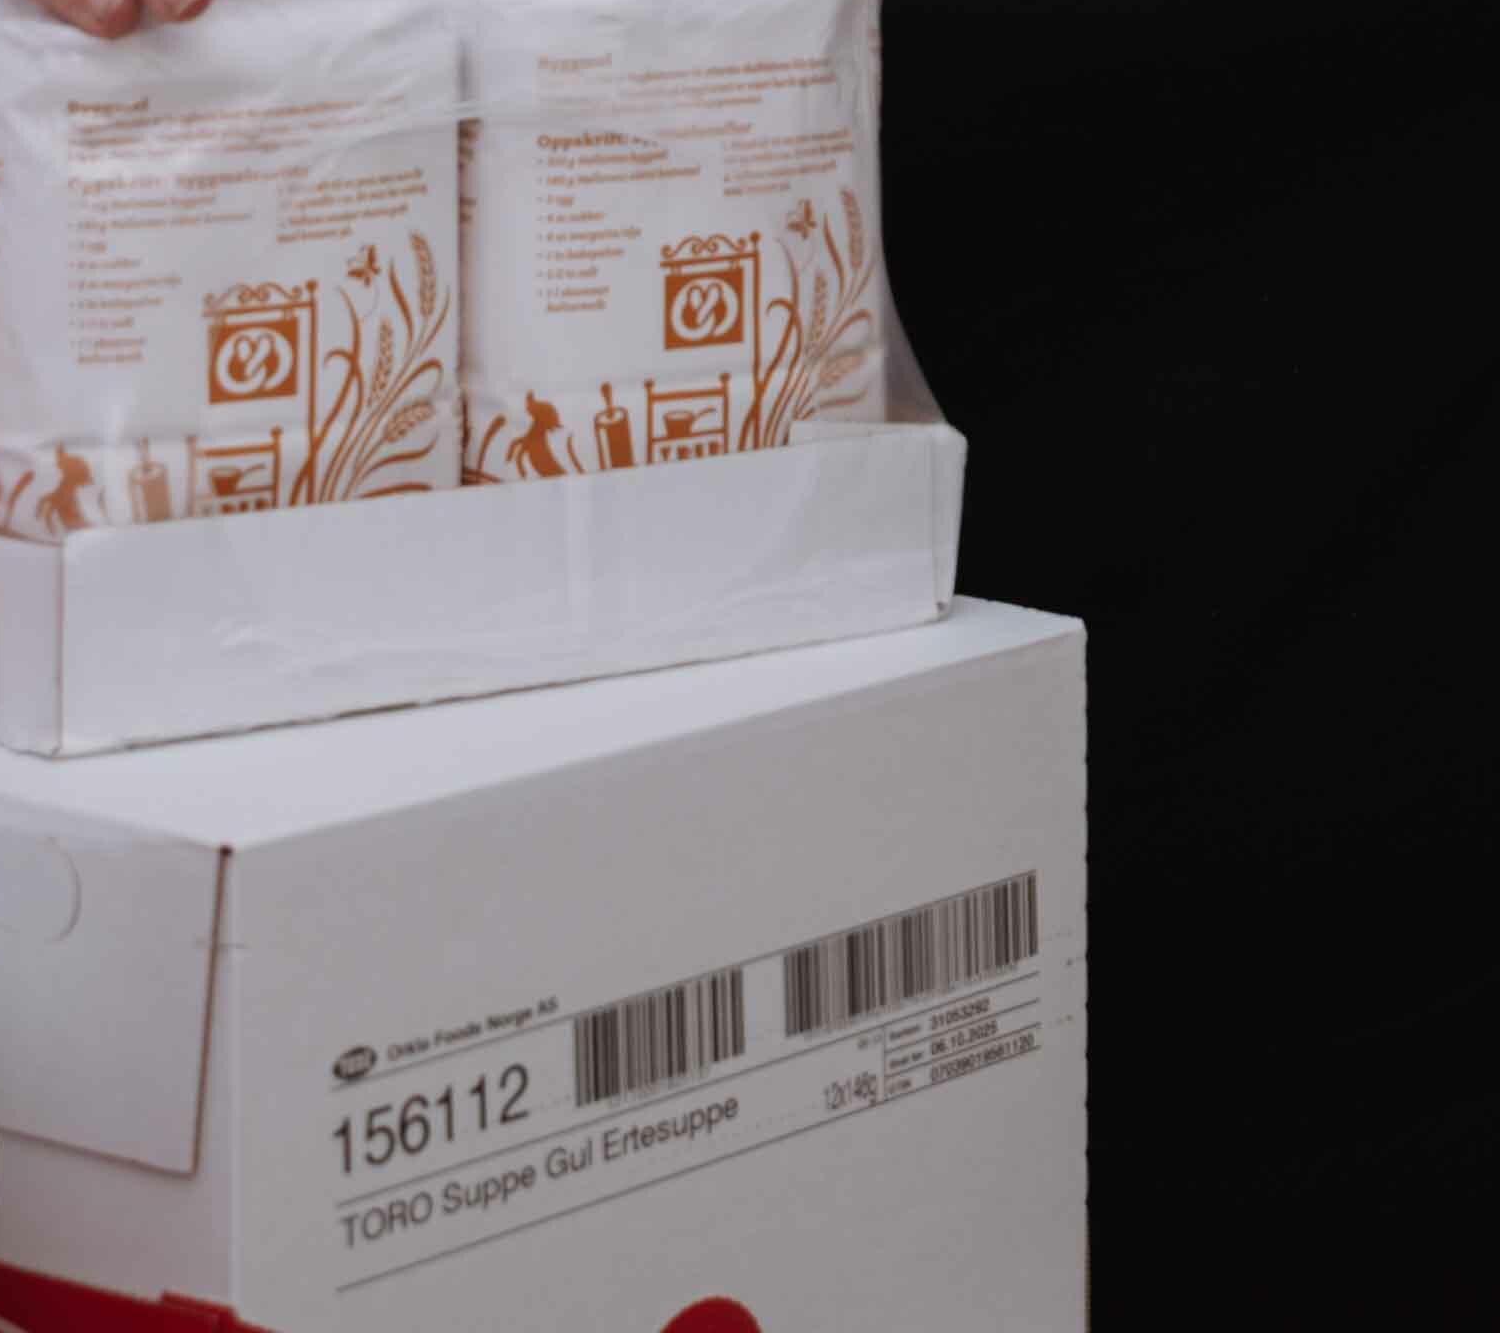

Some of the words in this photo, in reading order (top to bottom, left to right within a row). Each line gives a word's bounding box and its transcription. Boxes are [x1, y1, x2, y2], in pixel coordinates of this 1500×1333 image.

[333, 1063, 530, 1174] 156112
[340, 1192, 434, 1248] TORO
[442, 1164, 537, 1216] Suppe
[545, 1139, 593, 1181] Gul
[602, 1096, 739, 1161] Ertesuppe
